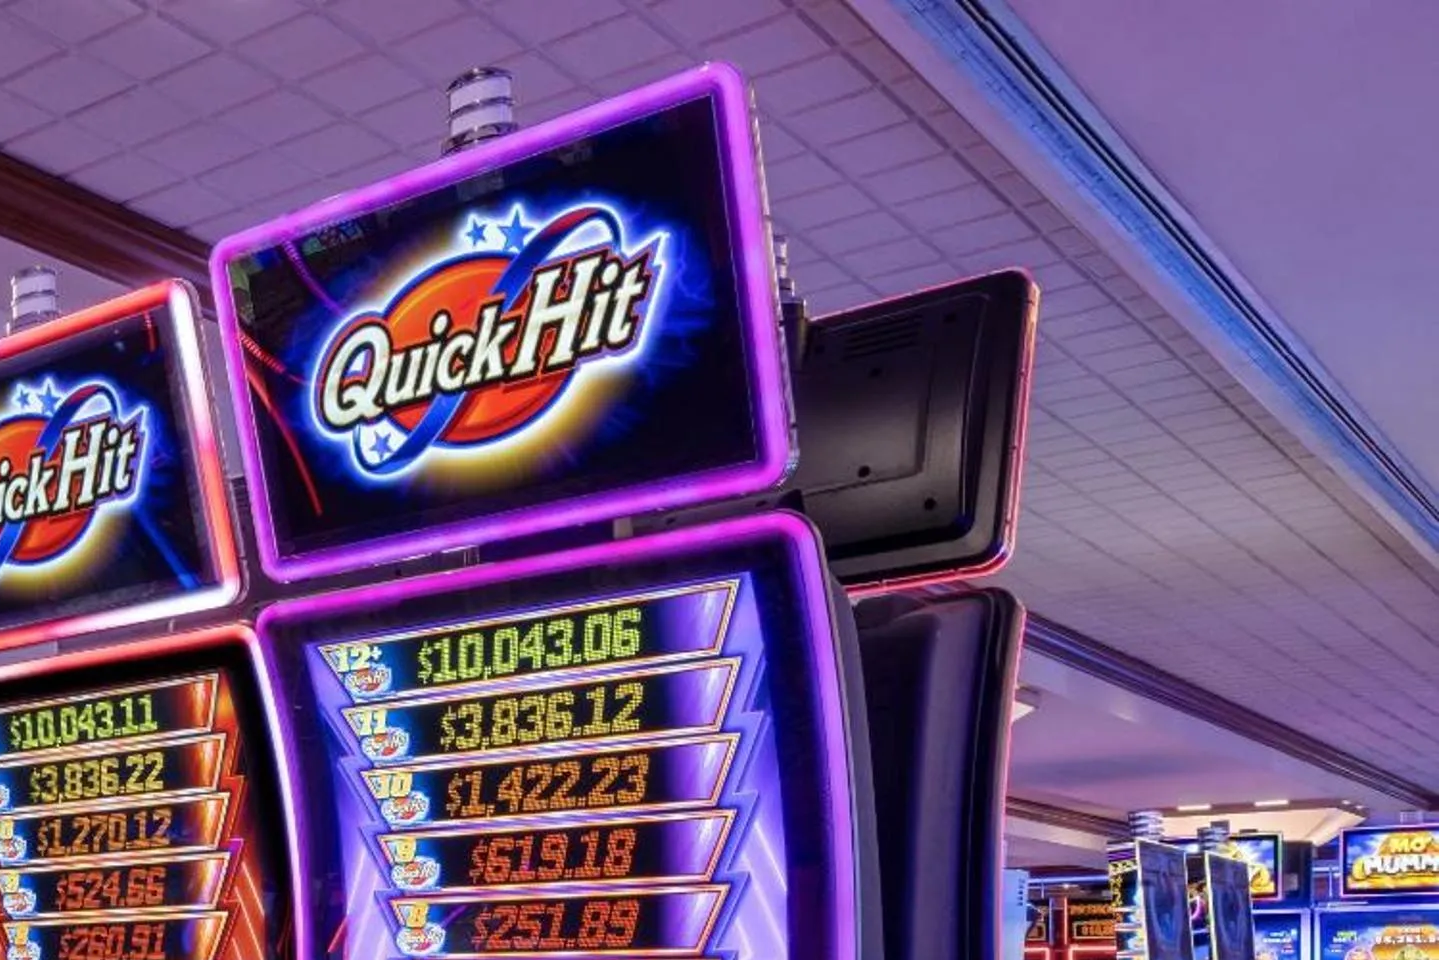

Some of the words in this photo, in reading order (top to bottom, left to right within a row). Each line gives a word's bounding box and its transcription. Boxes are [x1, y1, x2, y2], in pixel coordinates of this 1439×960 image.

[322, 302, 517, 428] Quick
[511, 254, 647, 376] Hit
[53, 421, 137, 510] Hit
[417, 607, 642, 685] $10,043.06
[10, 694, 158, 749] $10,043.11
[439, 682, 645, 753] $3,836.12
[30, 751, 165, 804] $3,836.22
[445, 753, 650, 818] $1,422.23
[37, 806, 172, 858] $1,270.12
[468, 828, 638, 886] $619.18
[472, 900, 640, 951] $251.89
